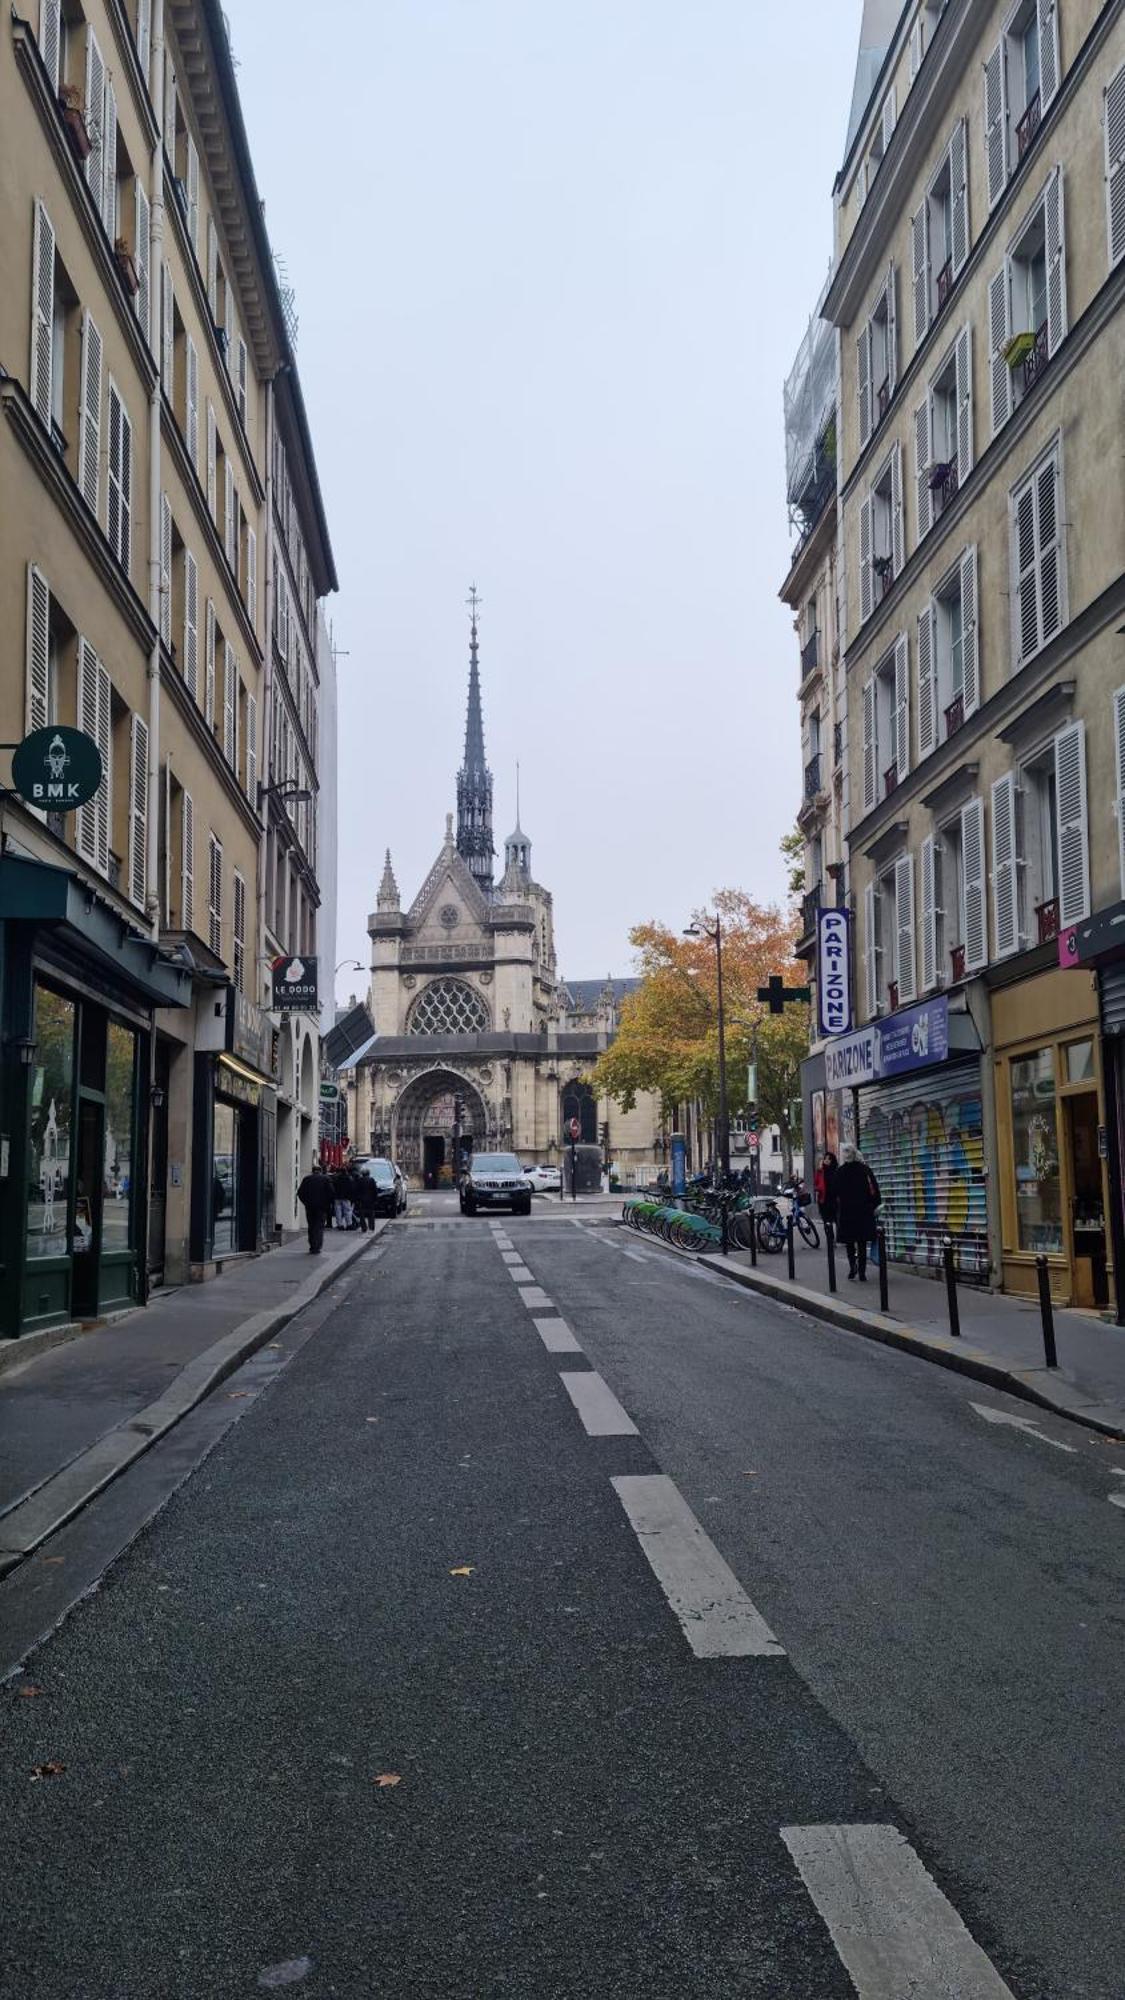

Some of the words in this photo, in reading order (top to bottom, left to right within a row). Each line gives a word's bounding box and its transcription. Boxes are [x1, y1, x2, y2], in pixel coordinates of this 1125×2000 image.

[33, 783, 79, 798] BMK
[825, 918, 844, 1027] PARIZONE
[275, 986, 285, 994] LE
[826, 1039, 872, 1081] PARIZONE
